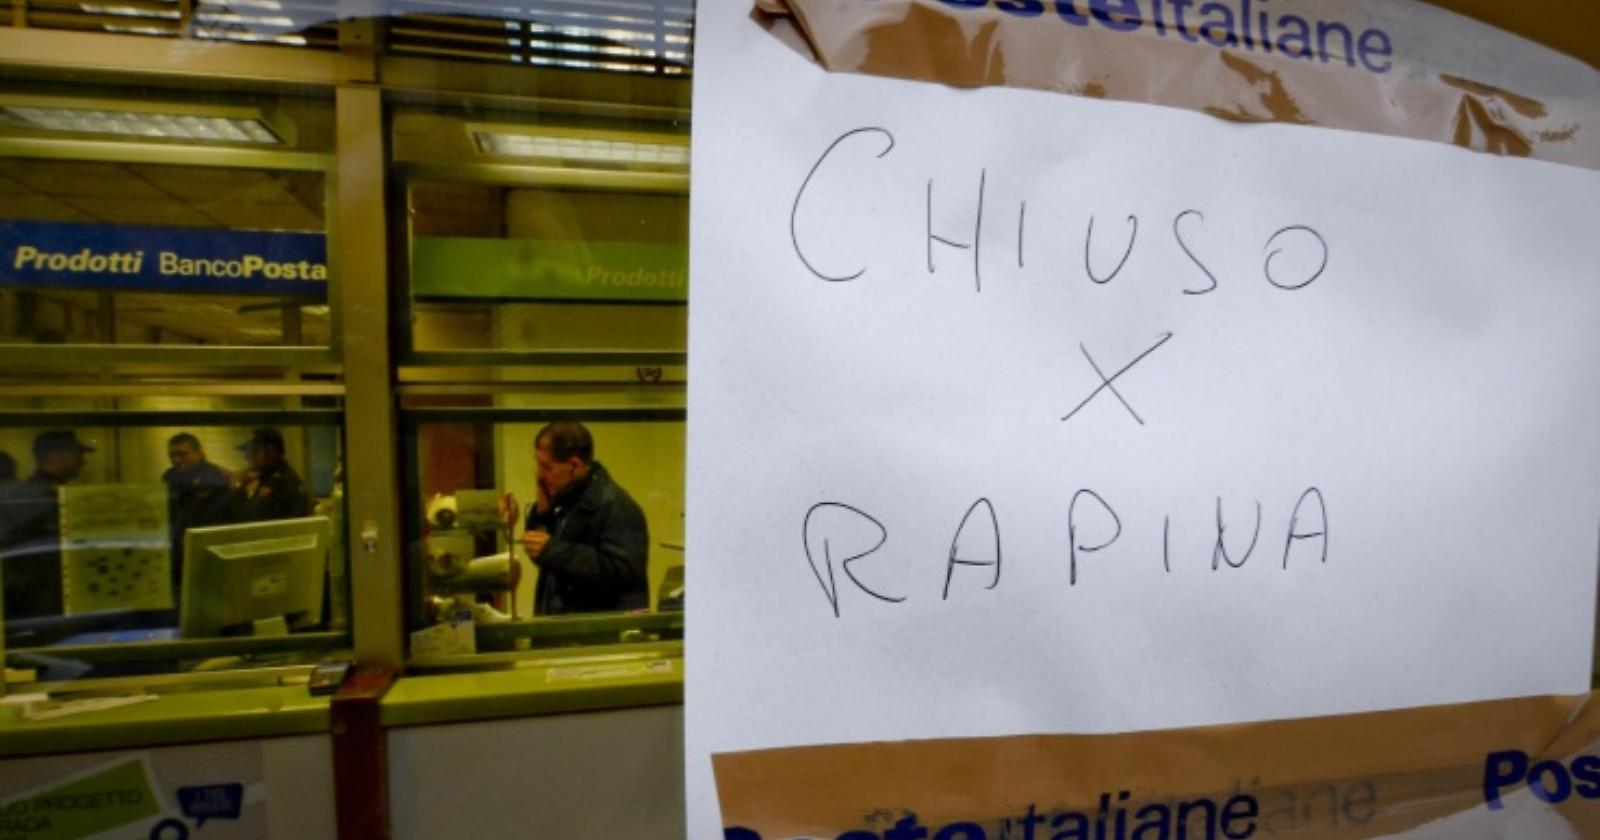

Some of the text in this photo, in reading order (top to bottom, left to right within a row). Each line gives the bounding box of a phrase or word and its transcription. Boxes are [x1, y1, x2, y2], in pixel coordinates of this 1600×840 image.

[791, 127, 1328, 295] CHIUSO
[13, 246, 327, 281] Prodotti BancoPosta
[1060, 332, 1174, 425] X
[803, 486, 1328, 618] RAPINA
[1484, 748, 1600, 811] Pos
